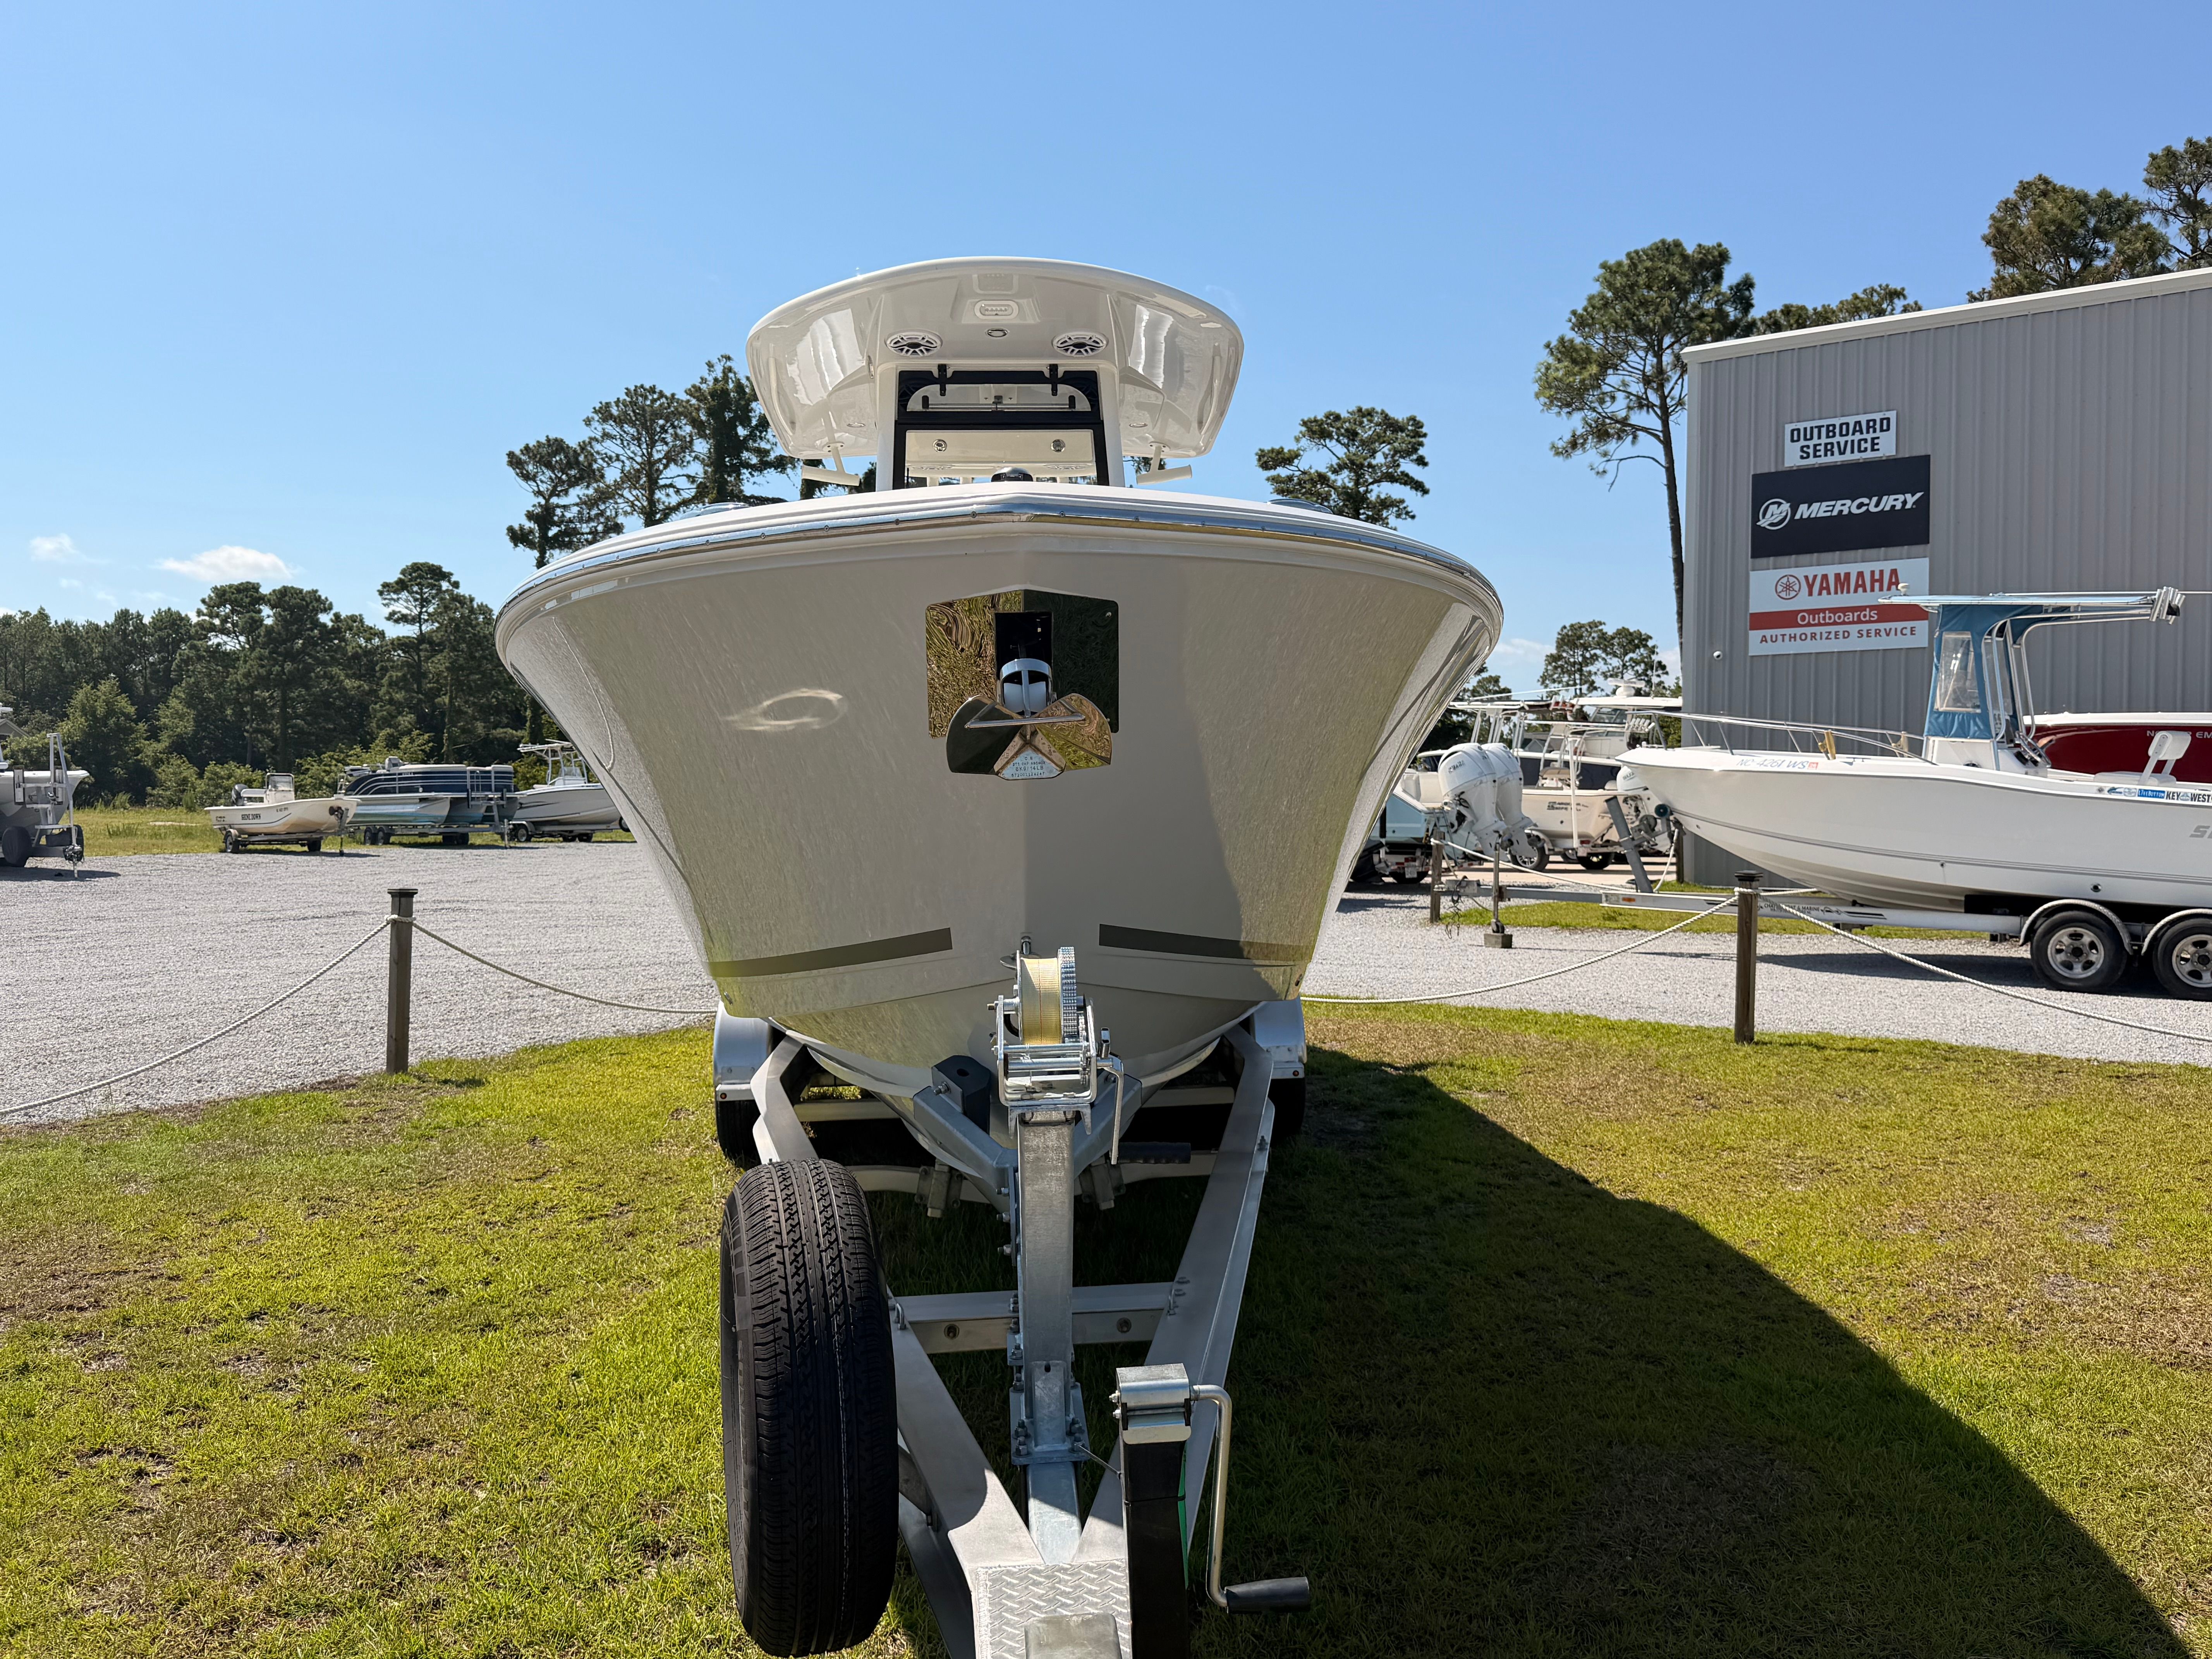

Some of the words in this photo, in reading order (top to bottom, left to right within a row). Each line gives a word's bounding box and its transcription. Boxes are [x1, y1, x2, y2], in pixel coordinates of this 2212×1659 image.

[1790, 417, 1891, 443] OUTBOARD
[1800, 436, 1880, 460] SERVICE
[1794, 492, 1924, 520] MERCURY
[1803, 568, 1900, 597] YAMAHA
[1797, 608, 1877, 625] Outboards
[1759, 630, 1850, 644] AUTHORIZED
[1857, 626, 1917, 639] SERVICE
[2166, 791, 2180, 800] KEY
[2190, 793, 2211, 803] WEST
[2189, 825, 2212, 839] S
